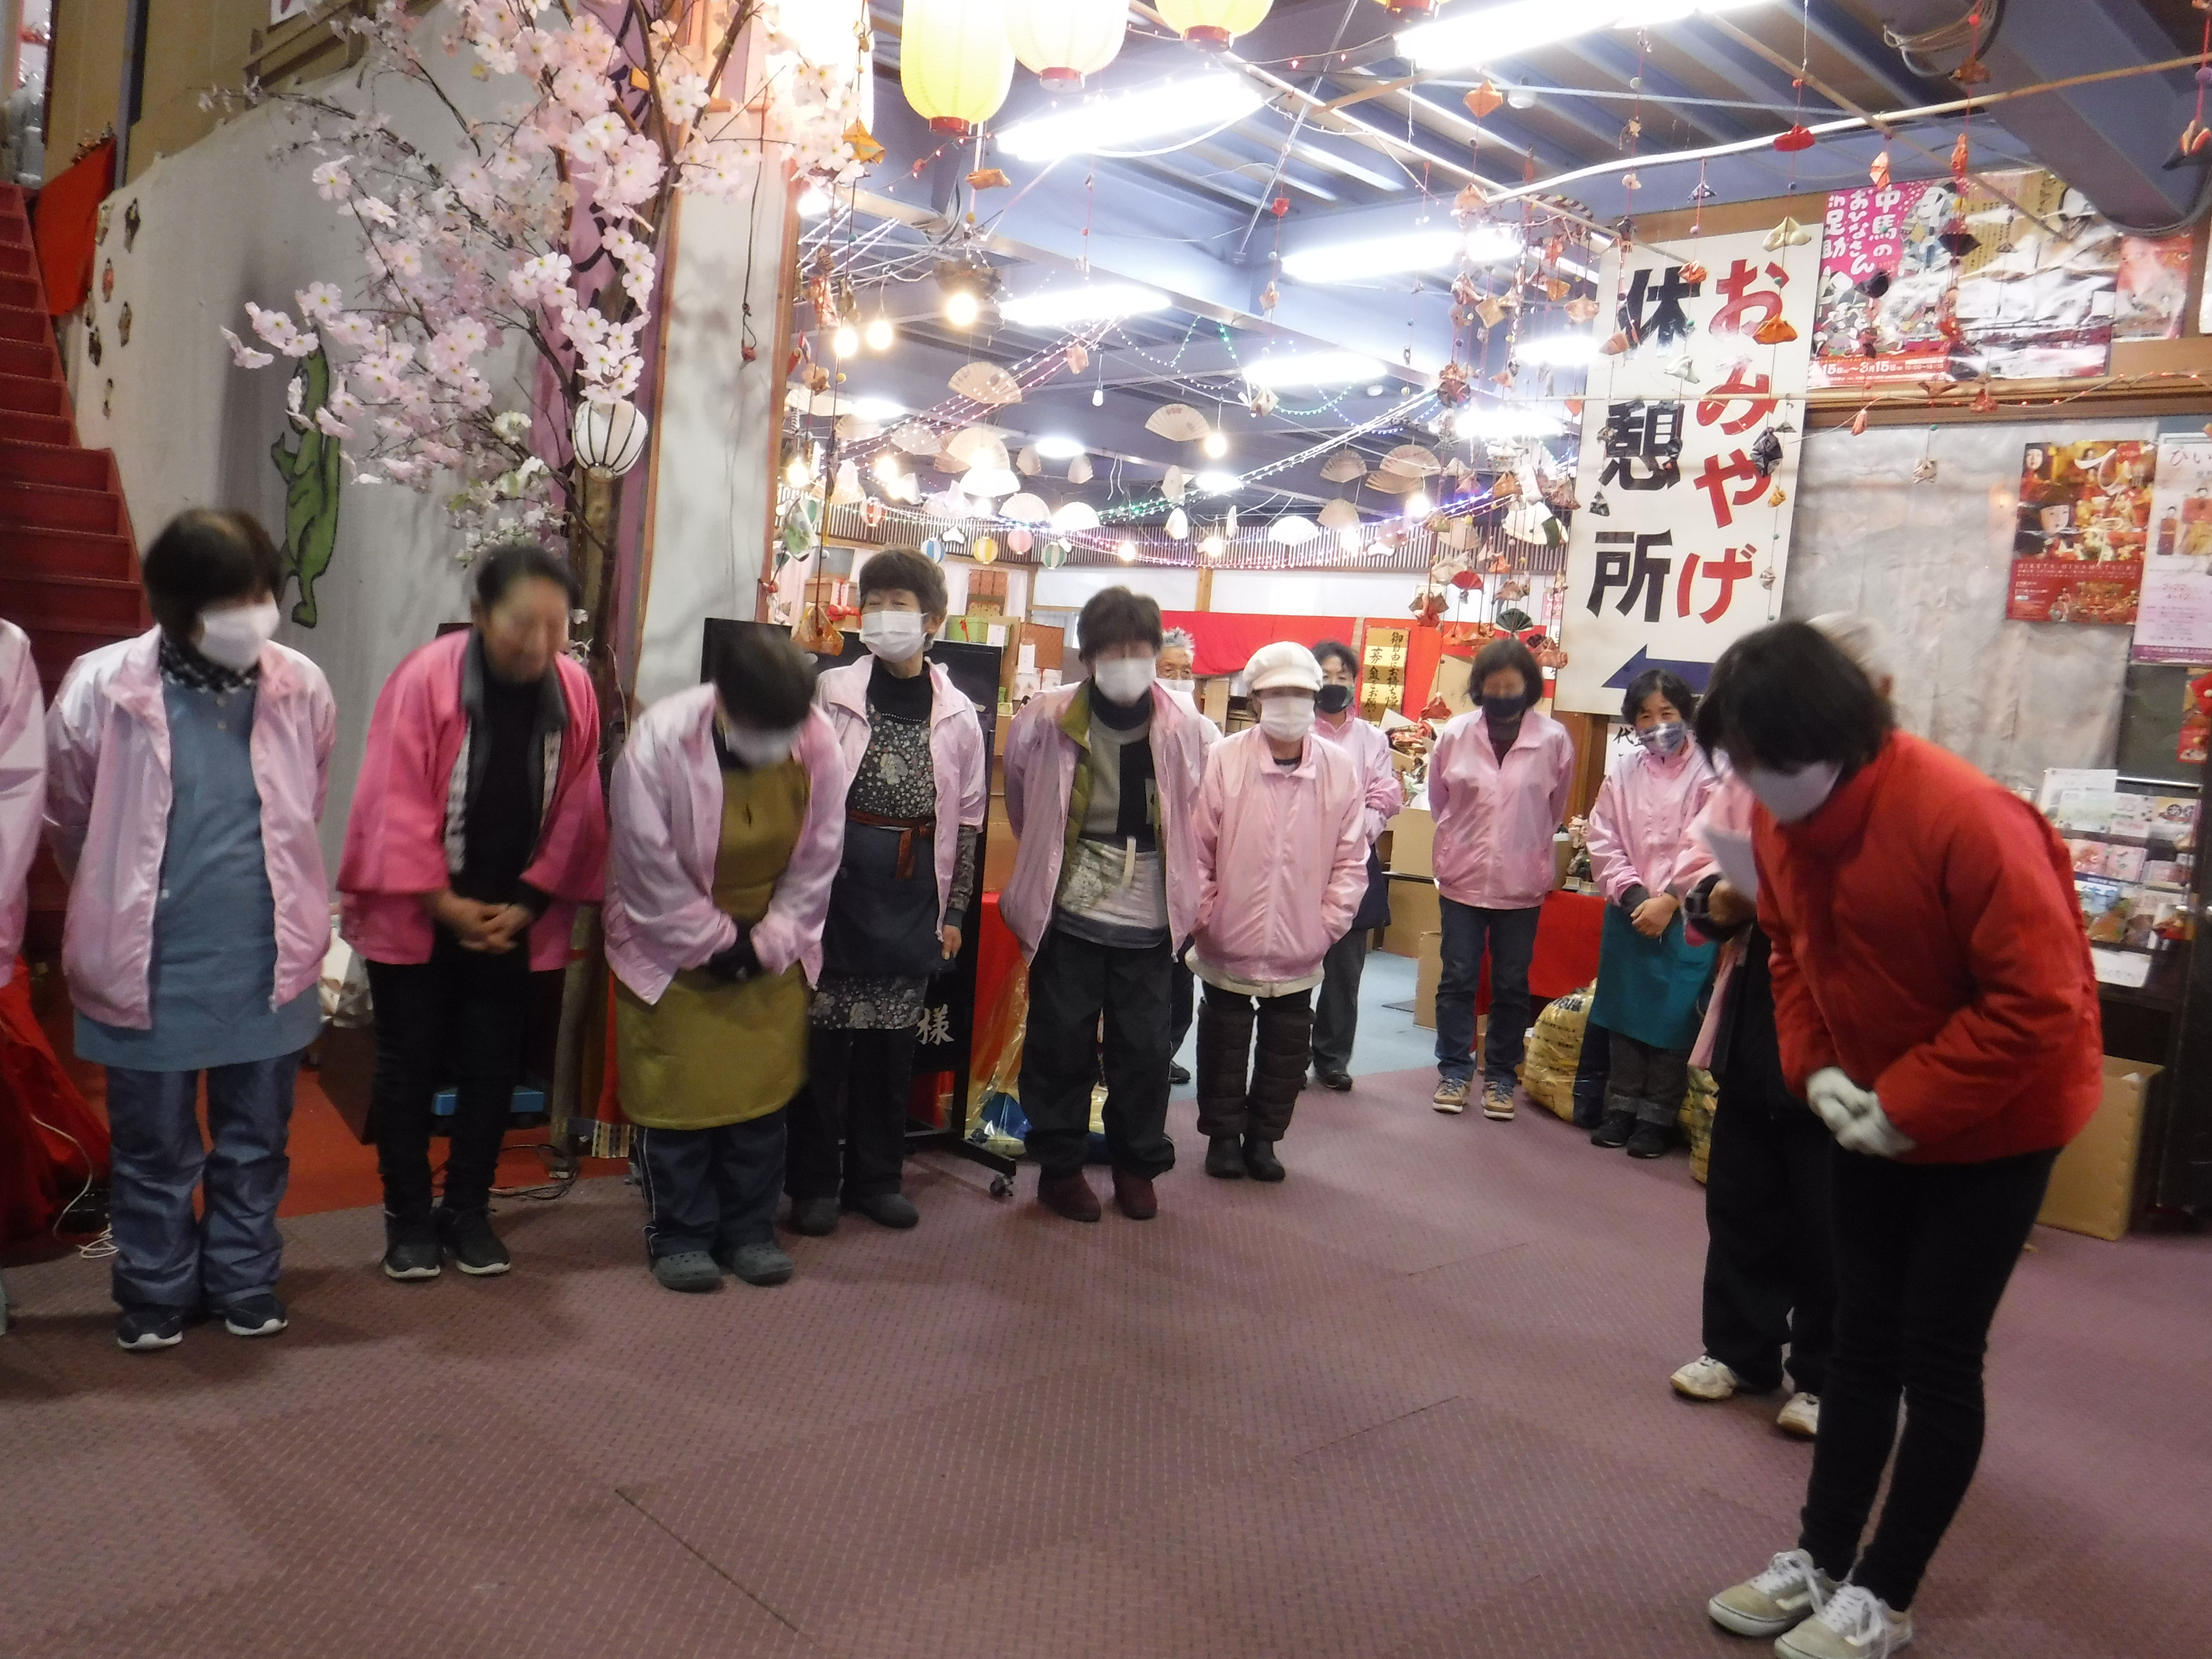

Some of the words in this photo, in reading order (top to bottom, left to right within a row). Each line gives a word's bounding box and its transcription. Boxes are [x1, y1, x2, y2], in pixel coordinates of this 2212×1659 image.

[1848, 190, 1875, 275] おひなさん
[1868, 190, 1901, 256] 中馬の
[1587, 266, 1702, 623] 休憩所
[1676, 259, 1790, 624] おみやげ
[915, 1003, 955, 1046] 様
